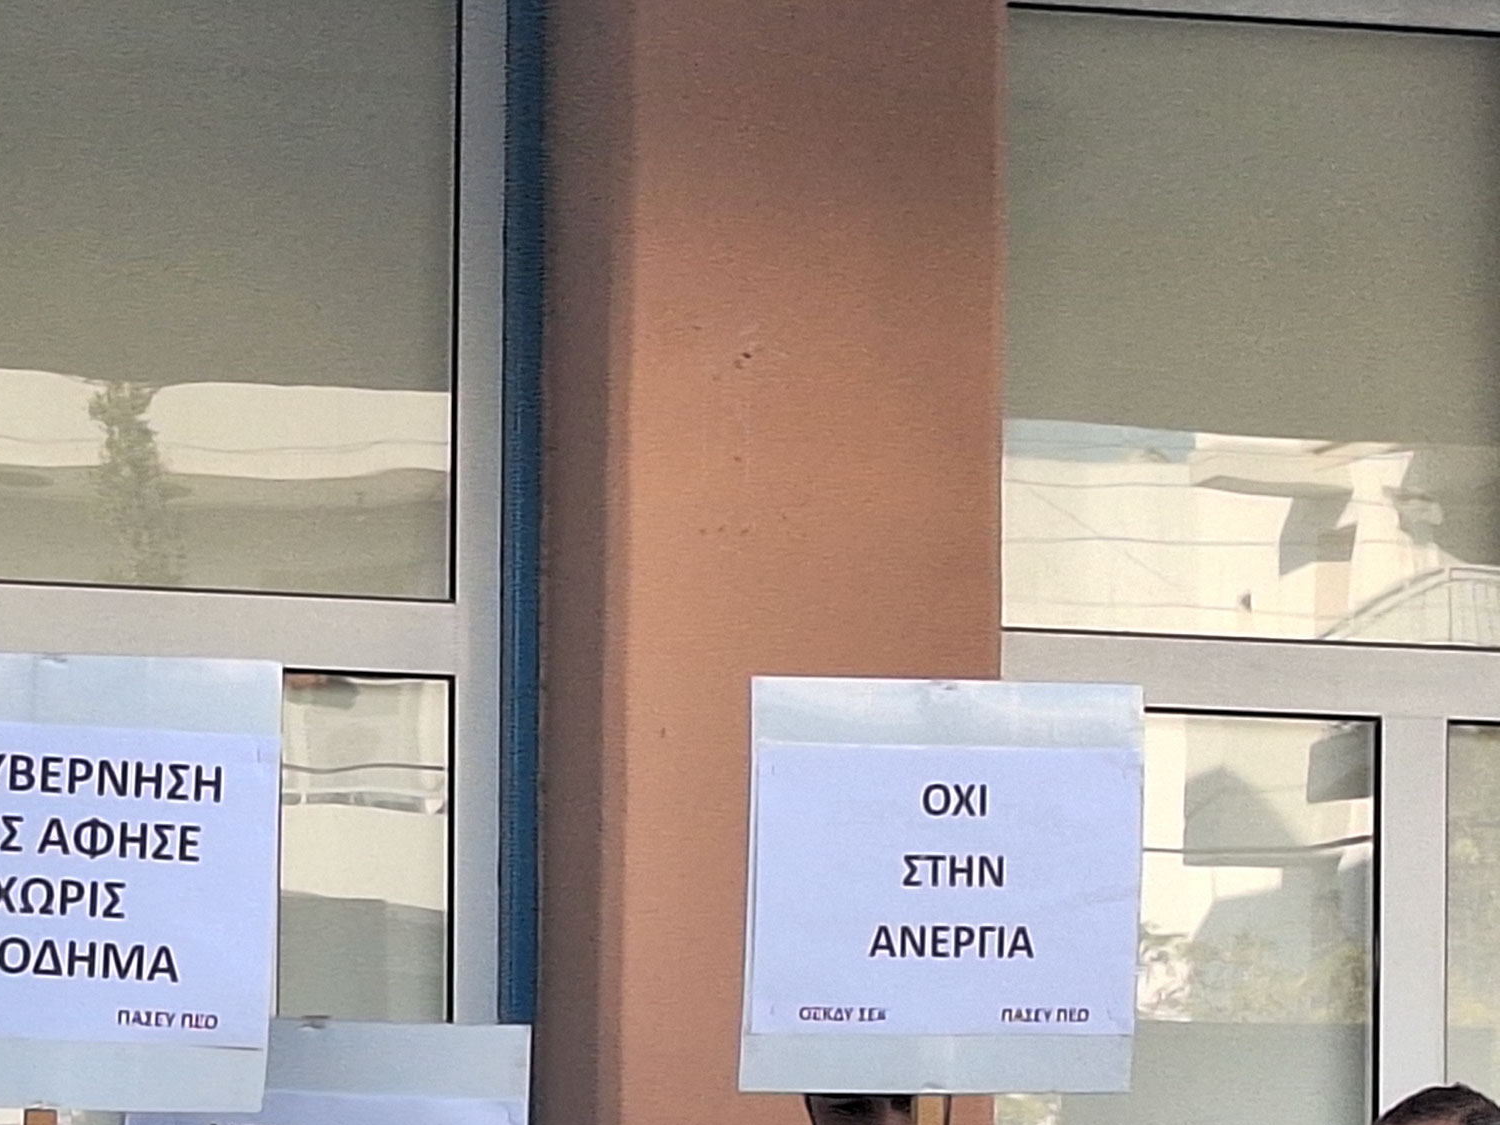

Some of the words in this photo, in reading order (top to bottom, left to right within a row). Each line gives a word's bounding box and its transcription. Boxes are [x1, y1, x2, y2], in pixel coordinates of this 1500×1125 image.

[922, 783, 987, 817] ΟΧΙ
[37, 817, 201, 862] ΑΦΗΣΕ
[902, 854, 1004, 888] ΣΤΗΝ
[869, 925, 1034, 959] ΑΝΕΡΓΙΑ
[117, 1009, 176, 1028] ΠΑΣΕΥ
[180, 1013, 219, 1030] ΠΕΟ
[798, 1006, 854, 1022] ΟΕΚΔΥ
[858, 1007, 886, 1022] ΣΕΚ
[1001, 1008, 1052, 1023] ΠΑΣΕΥ
